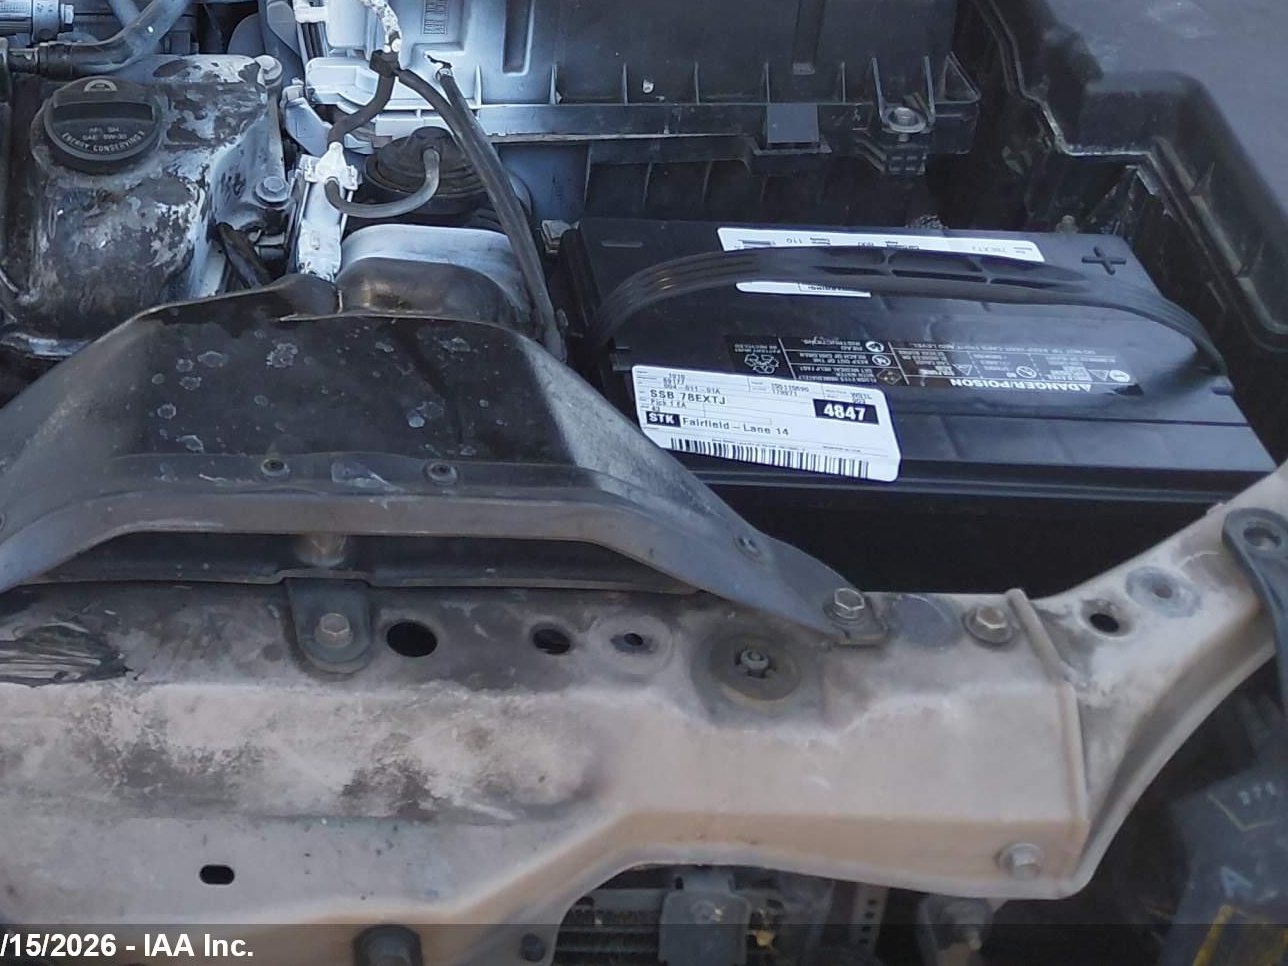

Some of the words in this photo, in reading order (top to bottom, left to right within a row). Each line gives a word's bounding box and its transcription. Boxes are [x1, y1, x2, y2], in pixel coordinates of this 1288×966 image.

[950, 378, 1082, 390] DANGER/POISON
[650, 388, 674, 400] SSB
[680, 392, 726, 406] 78EXTJ
[822, 403, 866, 422] 4847
[648, 412, 674, 424] STK
[682, 417, 730, 430] Fairfield
[743, 423, 771, 434] Lane
[776, 425, 790, 436] 14
